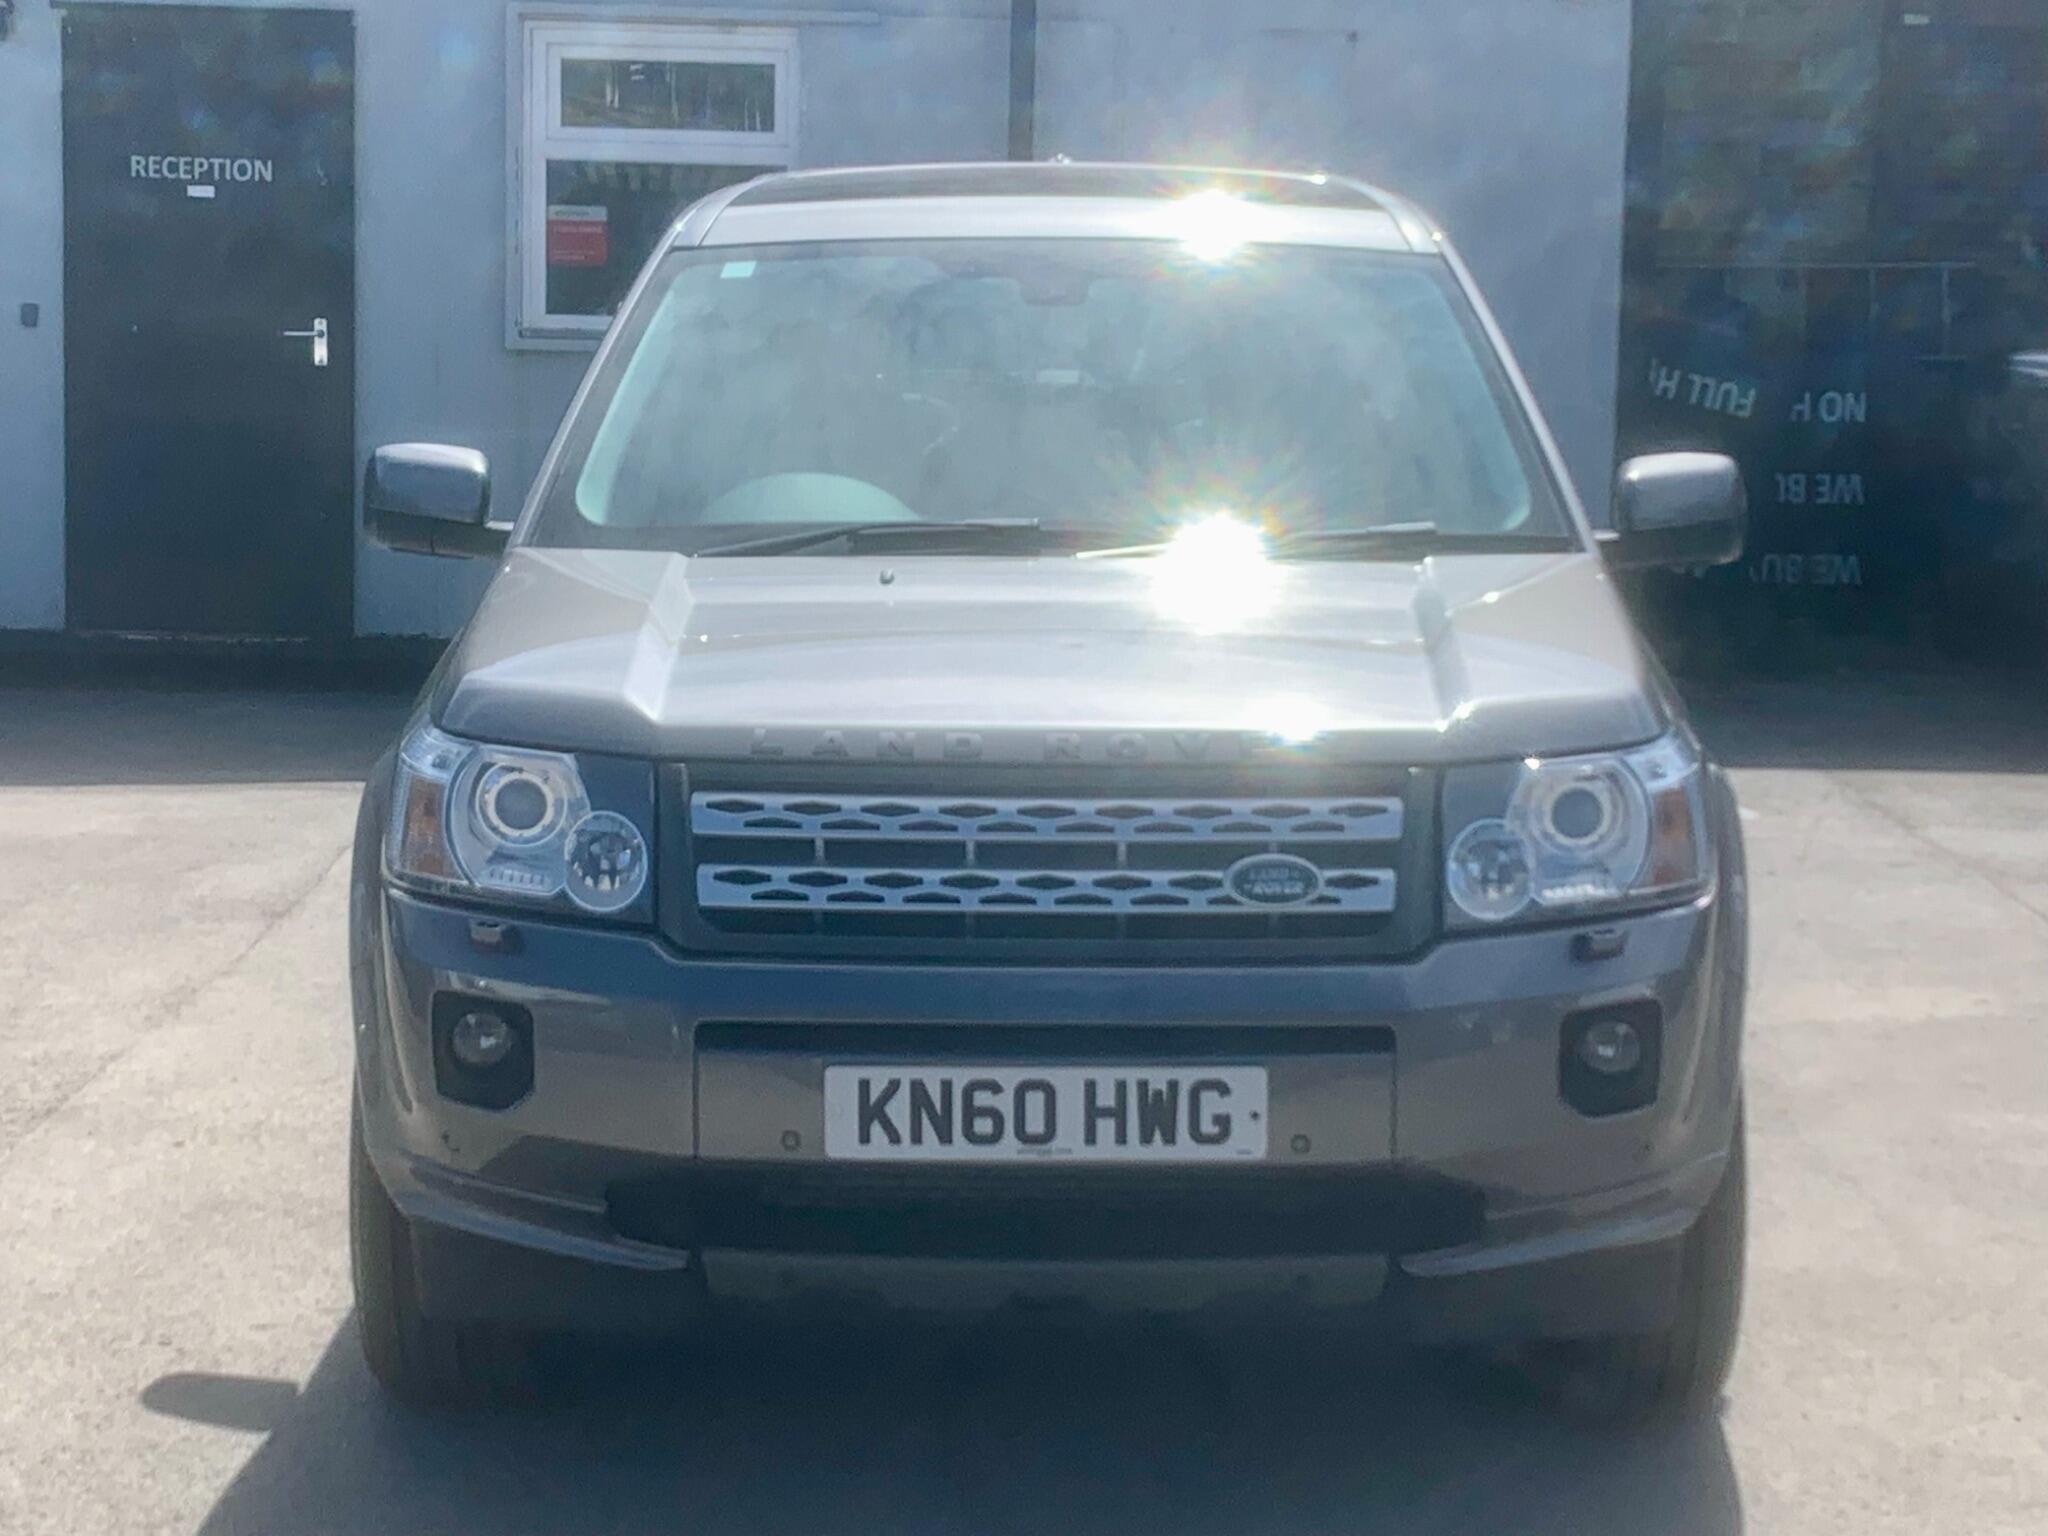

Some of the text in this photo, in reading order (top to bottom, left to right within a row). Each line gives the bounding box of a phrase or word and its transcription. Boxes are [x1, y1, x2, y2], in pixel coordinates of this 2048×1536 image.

[130, 155, 273, 183] RECEPTION
[1688, 372, 1757, 419] FULL
[1818, 391, 1867, 423] NO
[1815, 473, 1865, 505] WE
[1811, 553, 1863, 585] WE
[751, 727, 984, 760] LAND
[857, 1078, 1232, 1146] KN60 HWG
